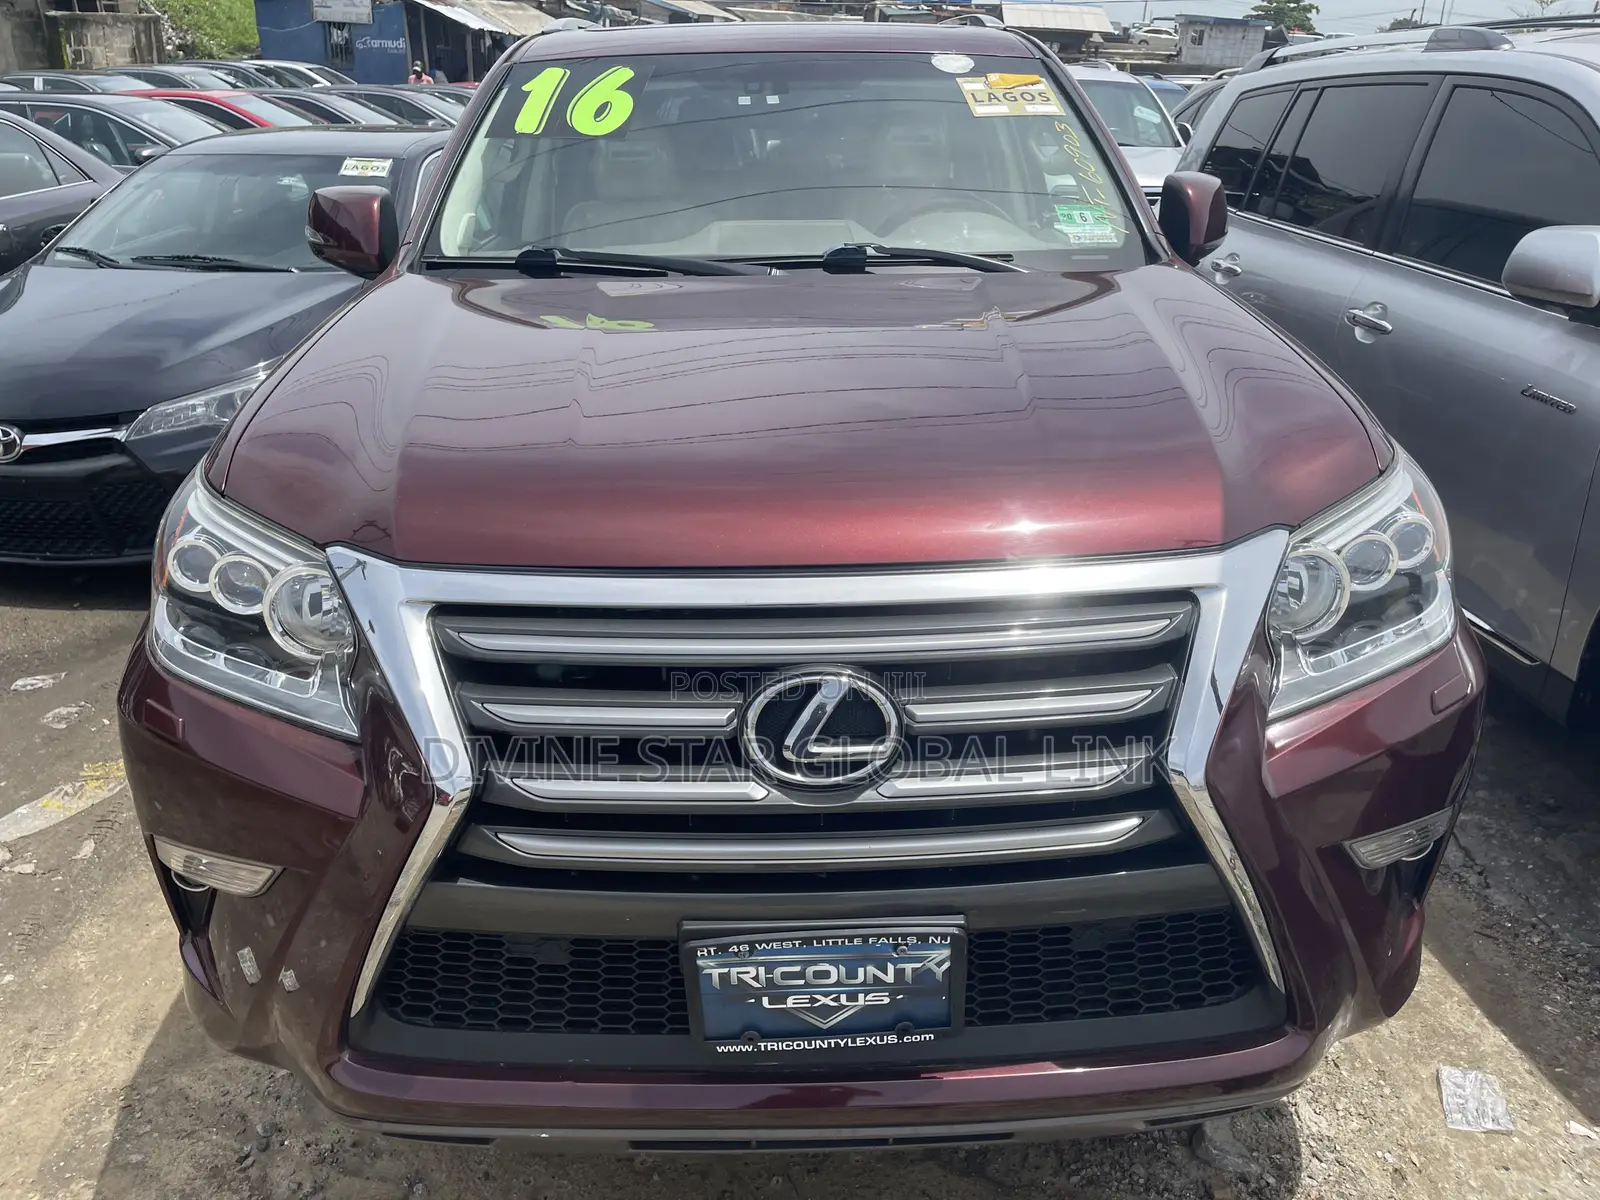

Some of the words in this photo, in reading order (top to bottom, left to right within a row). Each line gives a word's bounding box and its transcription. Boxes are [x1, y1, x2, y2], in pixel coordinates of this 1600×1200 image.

[514, 65, 635, 136] 16
[970, 91, 1051, 103] LAGOS
[344, 164, 387, 172] LAGOS
[728, 944, 750, 953] 46
[813, 937, 863, 947] LITTLE
[928, 936, 951, 944] NJ
[701, 961, 951, 990] TRI-COUNTY
[762, 992, 890, 1009] LEXUS
[716, 1033, 935, 1053] www.TRICOUNTYLEXUS.com
